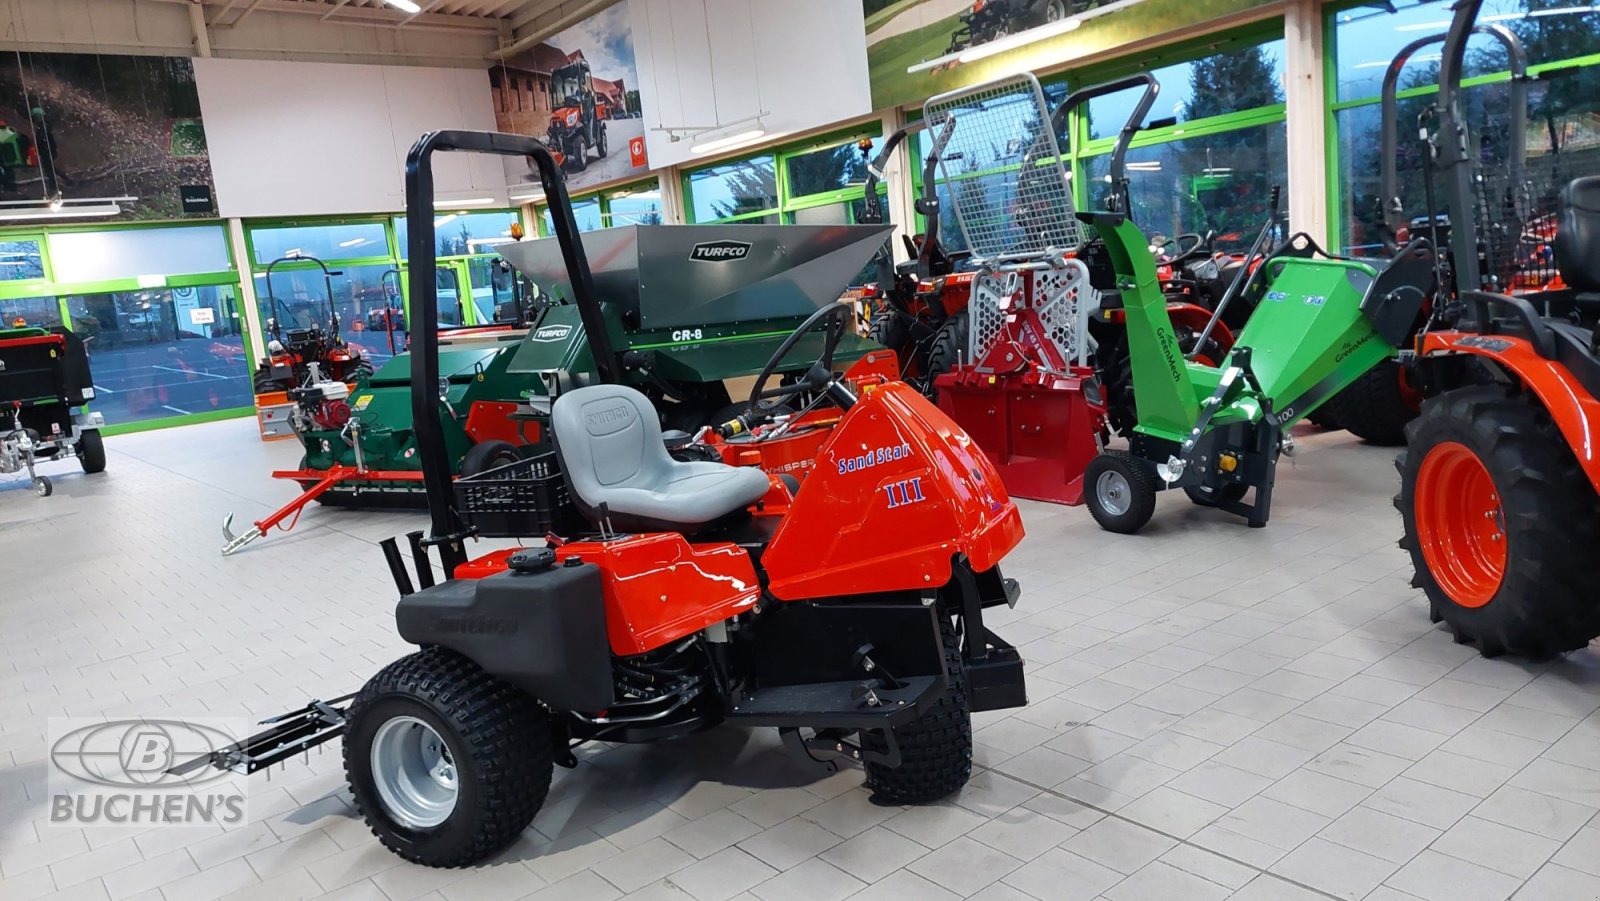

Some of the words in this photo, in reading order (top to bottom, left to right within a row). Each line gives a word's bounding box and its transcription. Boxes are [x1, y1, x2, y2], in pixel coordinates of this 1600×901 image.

[697, 247, 746, 257] TURFCO
[537, 329, 568, 338] TURFCO
[672, 328, 702, 342] CR-8
[1157, 327, 1181, 383] GreenMech
[1277, 407, 1294, 425] 100
[883, 476, 926, 509] III
